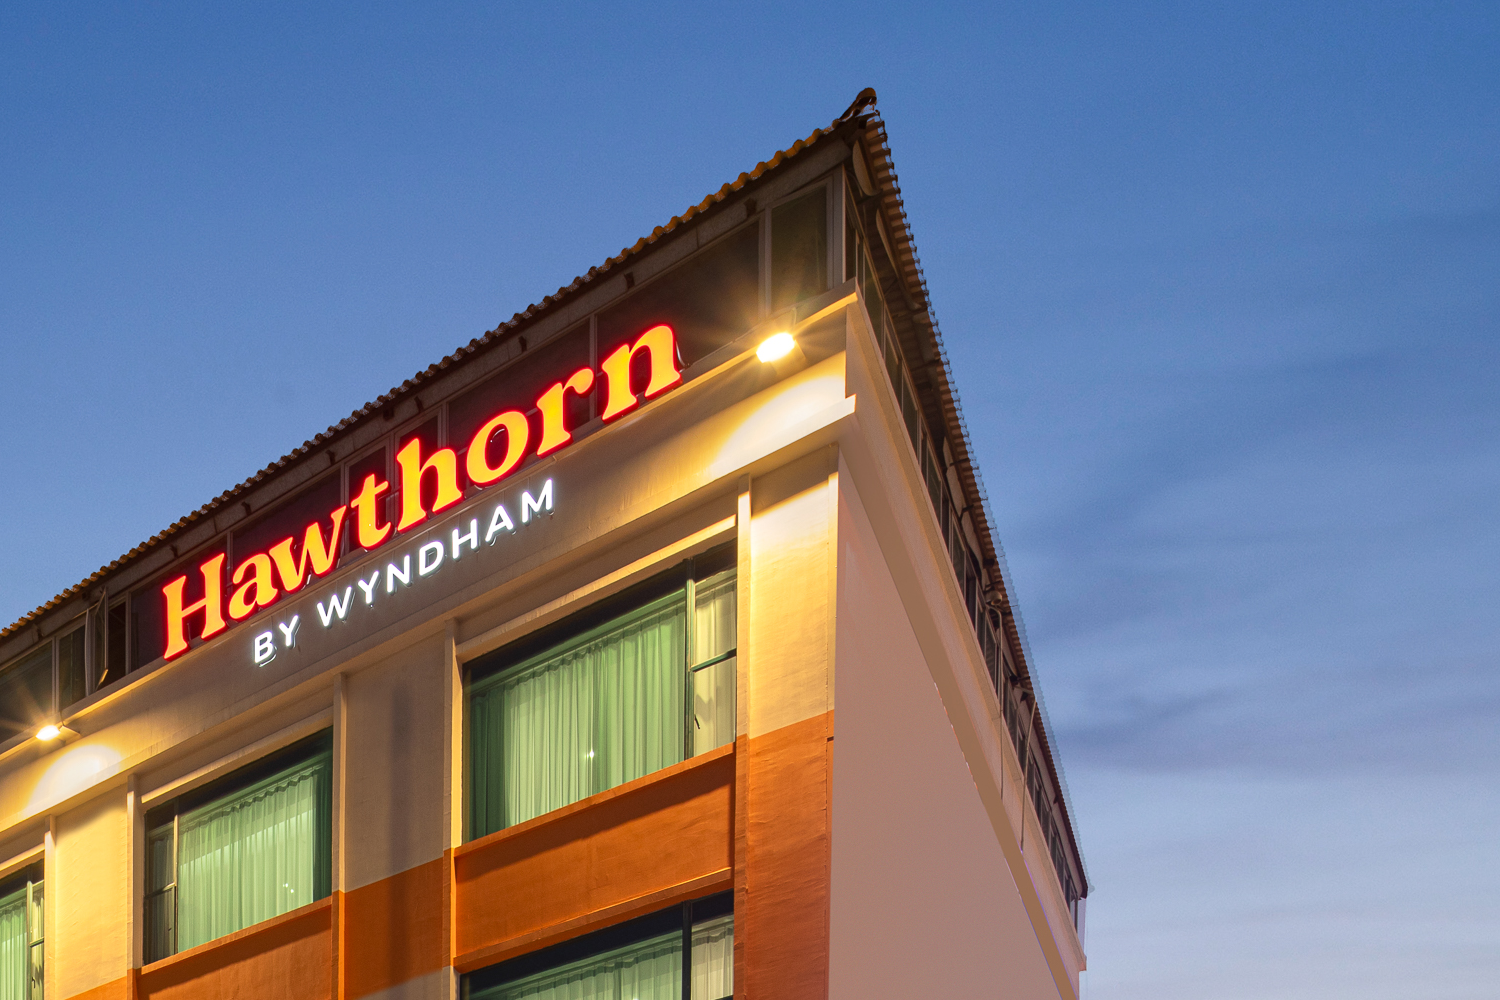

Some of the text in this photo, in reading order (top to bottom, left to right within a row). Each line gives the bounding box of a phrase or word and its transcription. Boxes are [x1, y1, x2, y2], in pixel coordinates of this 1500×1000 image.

[162, 323, 682, 661] Hawthorn
[254, 478, 554, 664] BY WYNDHAM
